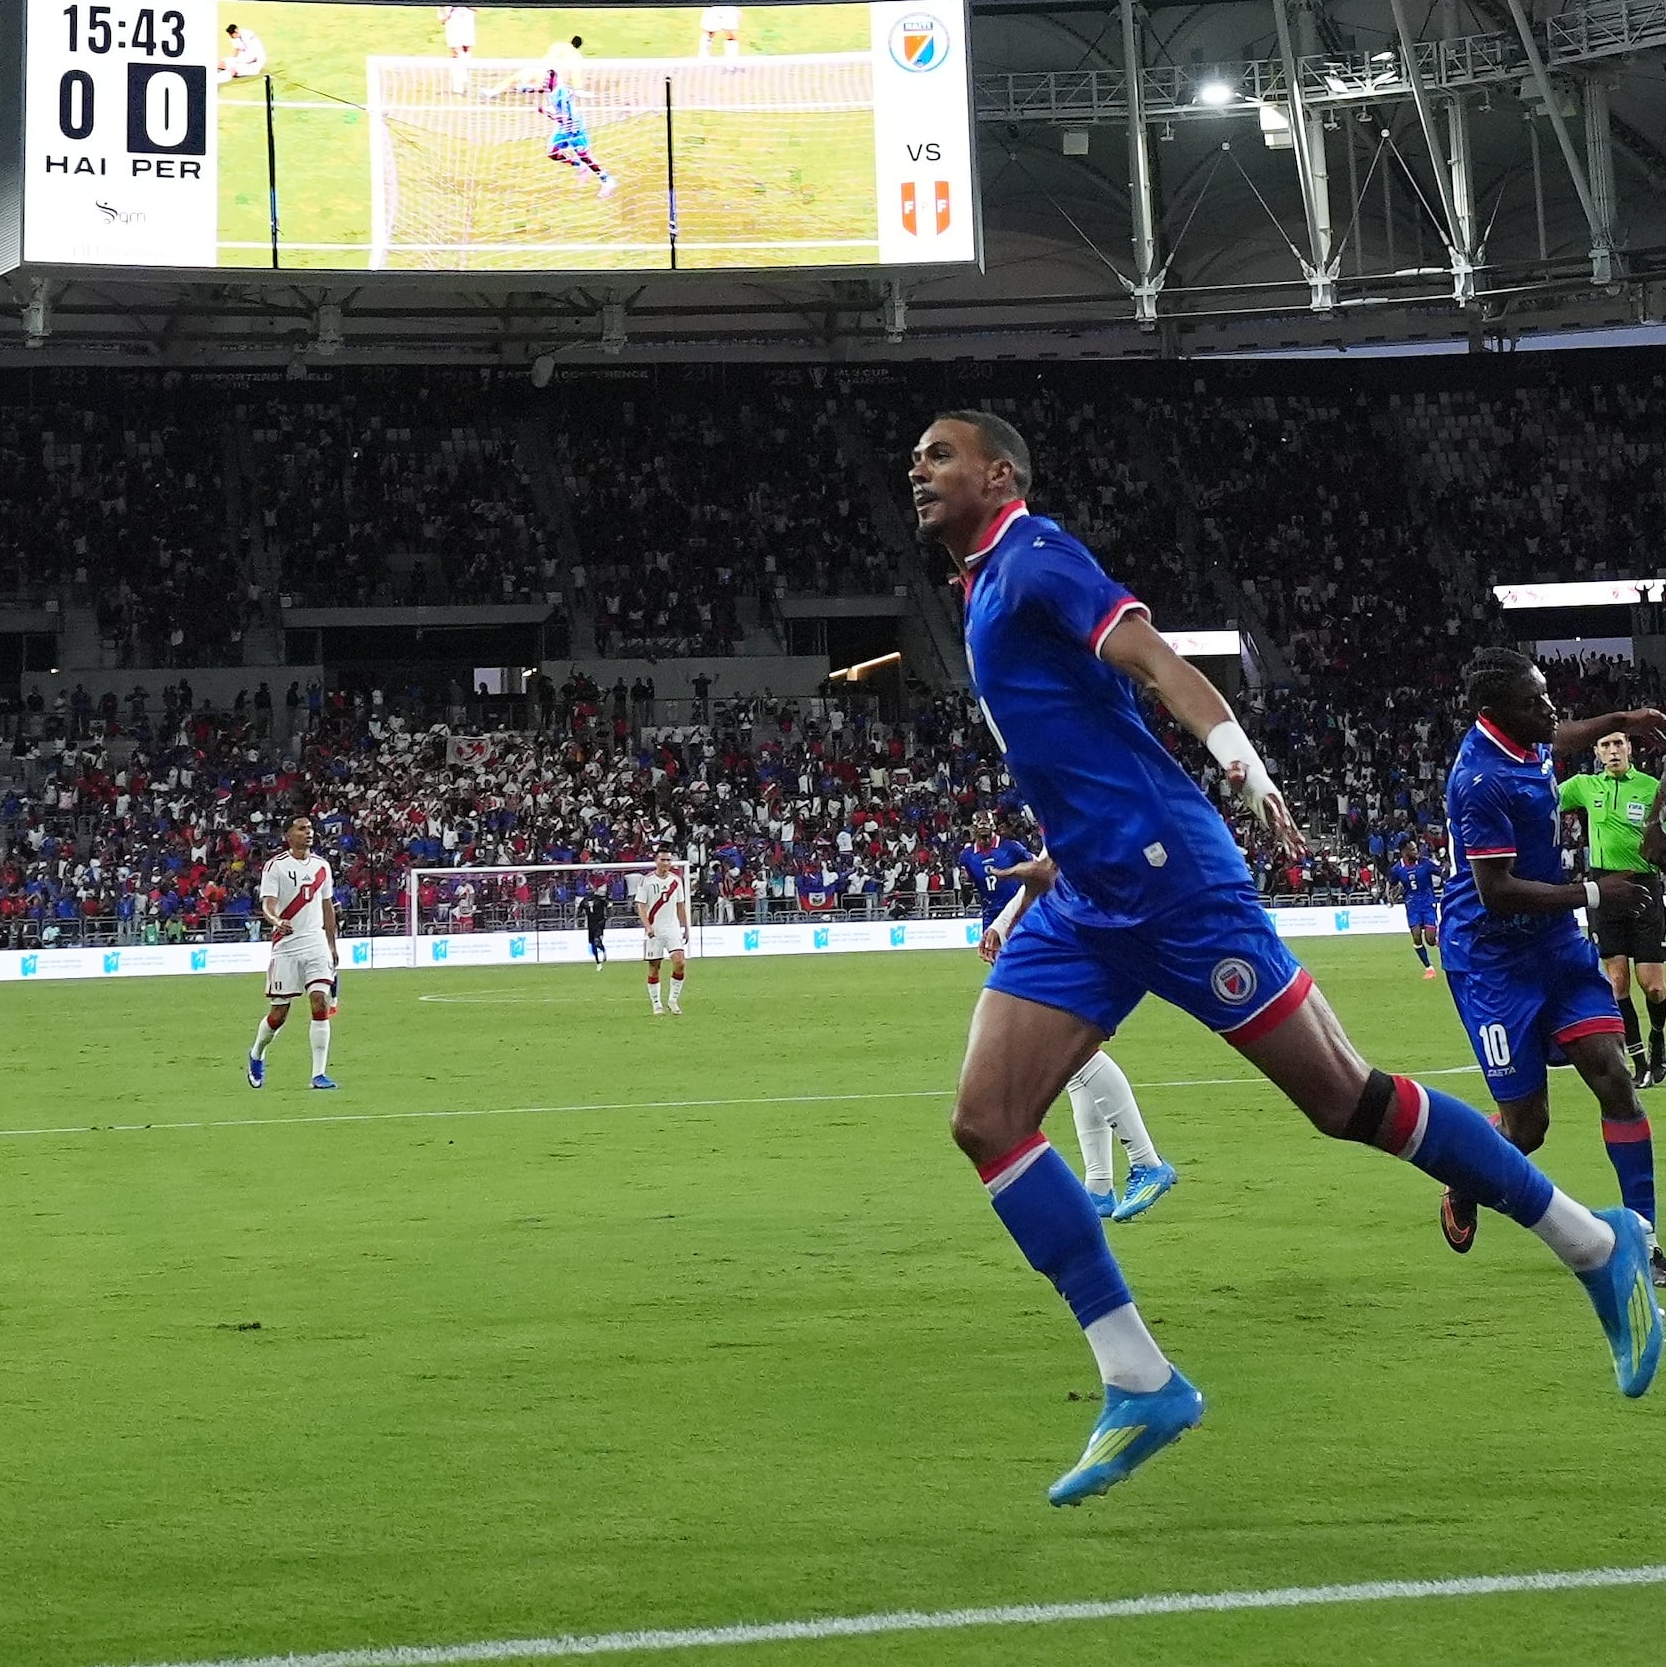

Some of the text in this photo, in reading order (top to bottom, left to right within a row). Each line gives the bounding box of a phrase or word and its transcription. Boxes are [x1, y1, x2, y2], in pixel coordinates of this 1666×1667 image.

[63, 4, 186, 59] 15:43
[59, 69, 188, 147] 0 0
[45, 154, 202, 180] HAI PER
[287, 870, 297, 887] 4
[1478, 1023, 1511, 1068] 10
